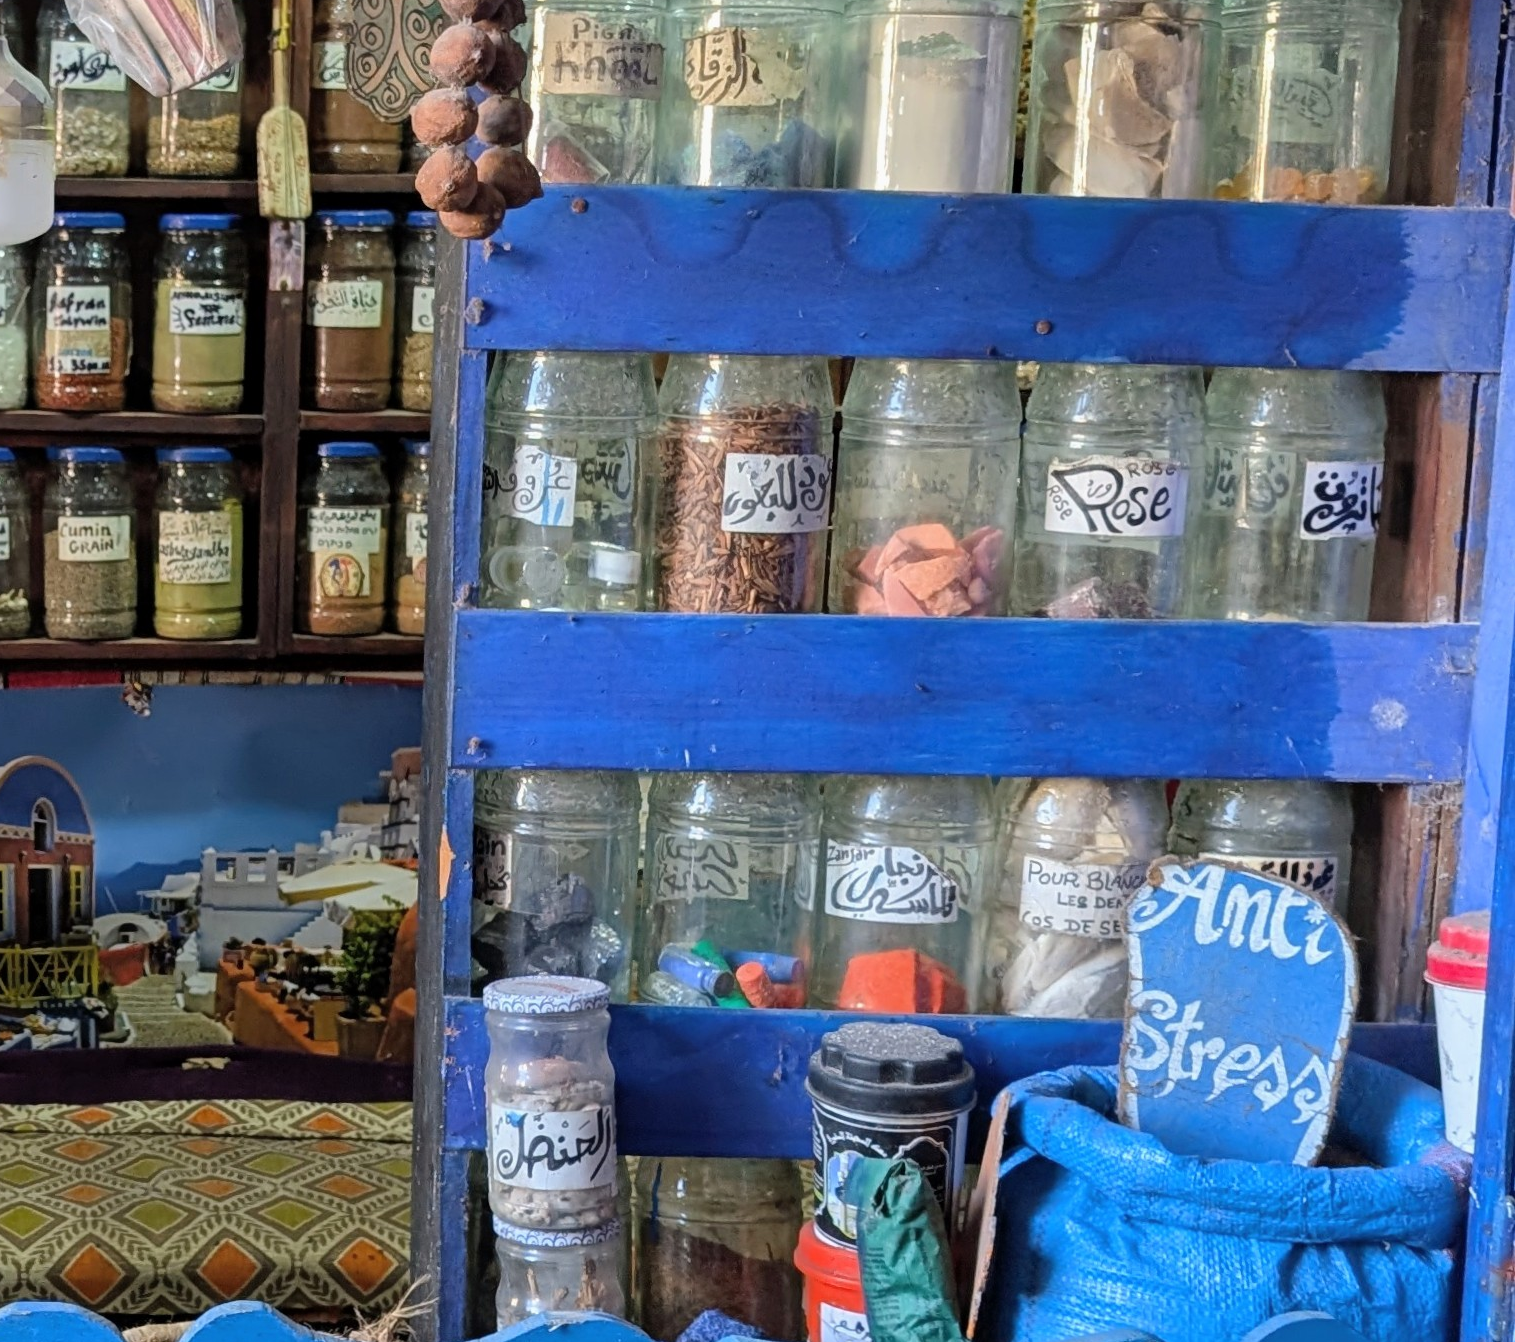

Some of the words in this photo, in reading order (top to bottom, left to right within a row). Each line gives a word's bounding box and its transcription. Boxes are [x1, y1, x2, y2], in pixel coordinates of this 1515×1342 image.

[1051, 465, 1172, 534] Rose
[1028, 860, 1079, 888] POUR
[1129, 863, 1333, 966] Anti
[1129, 989, 1331, 1124] Stress
